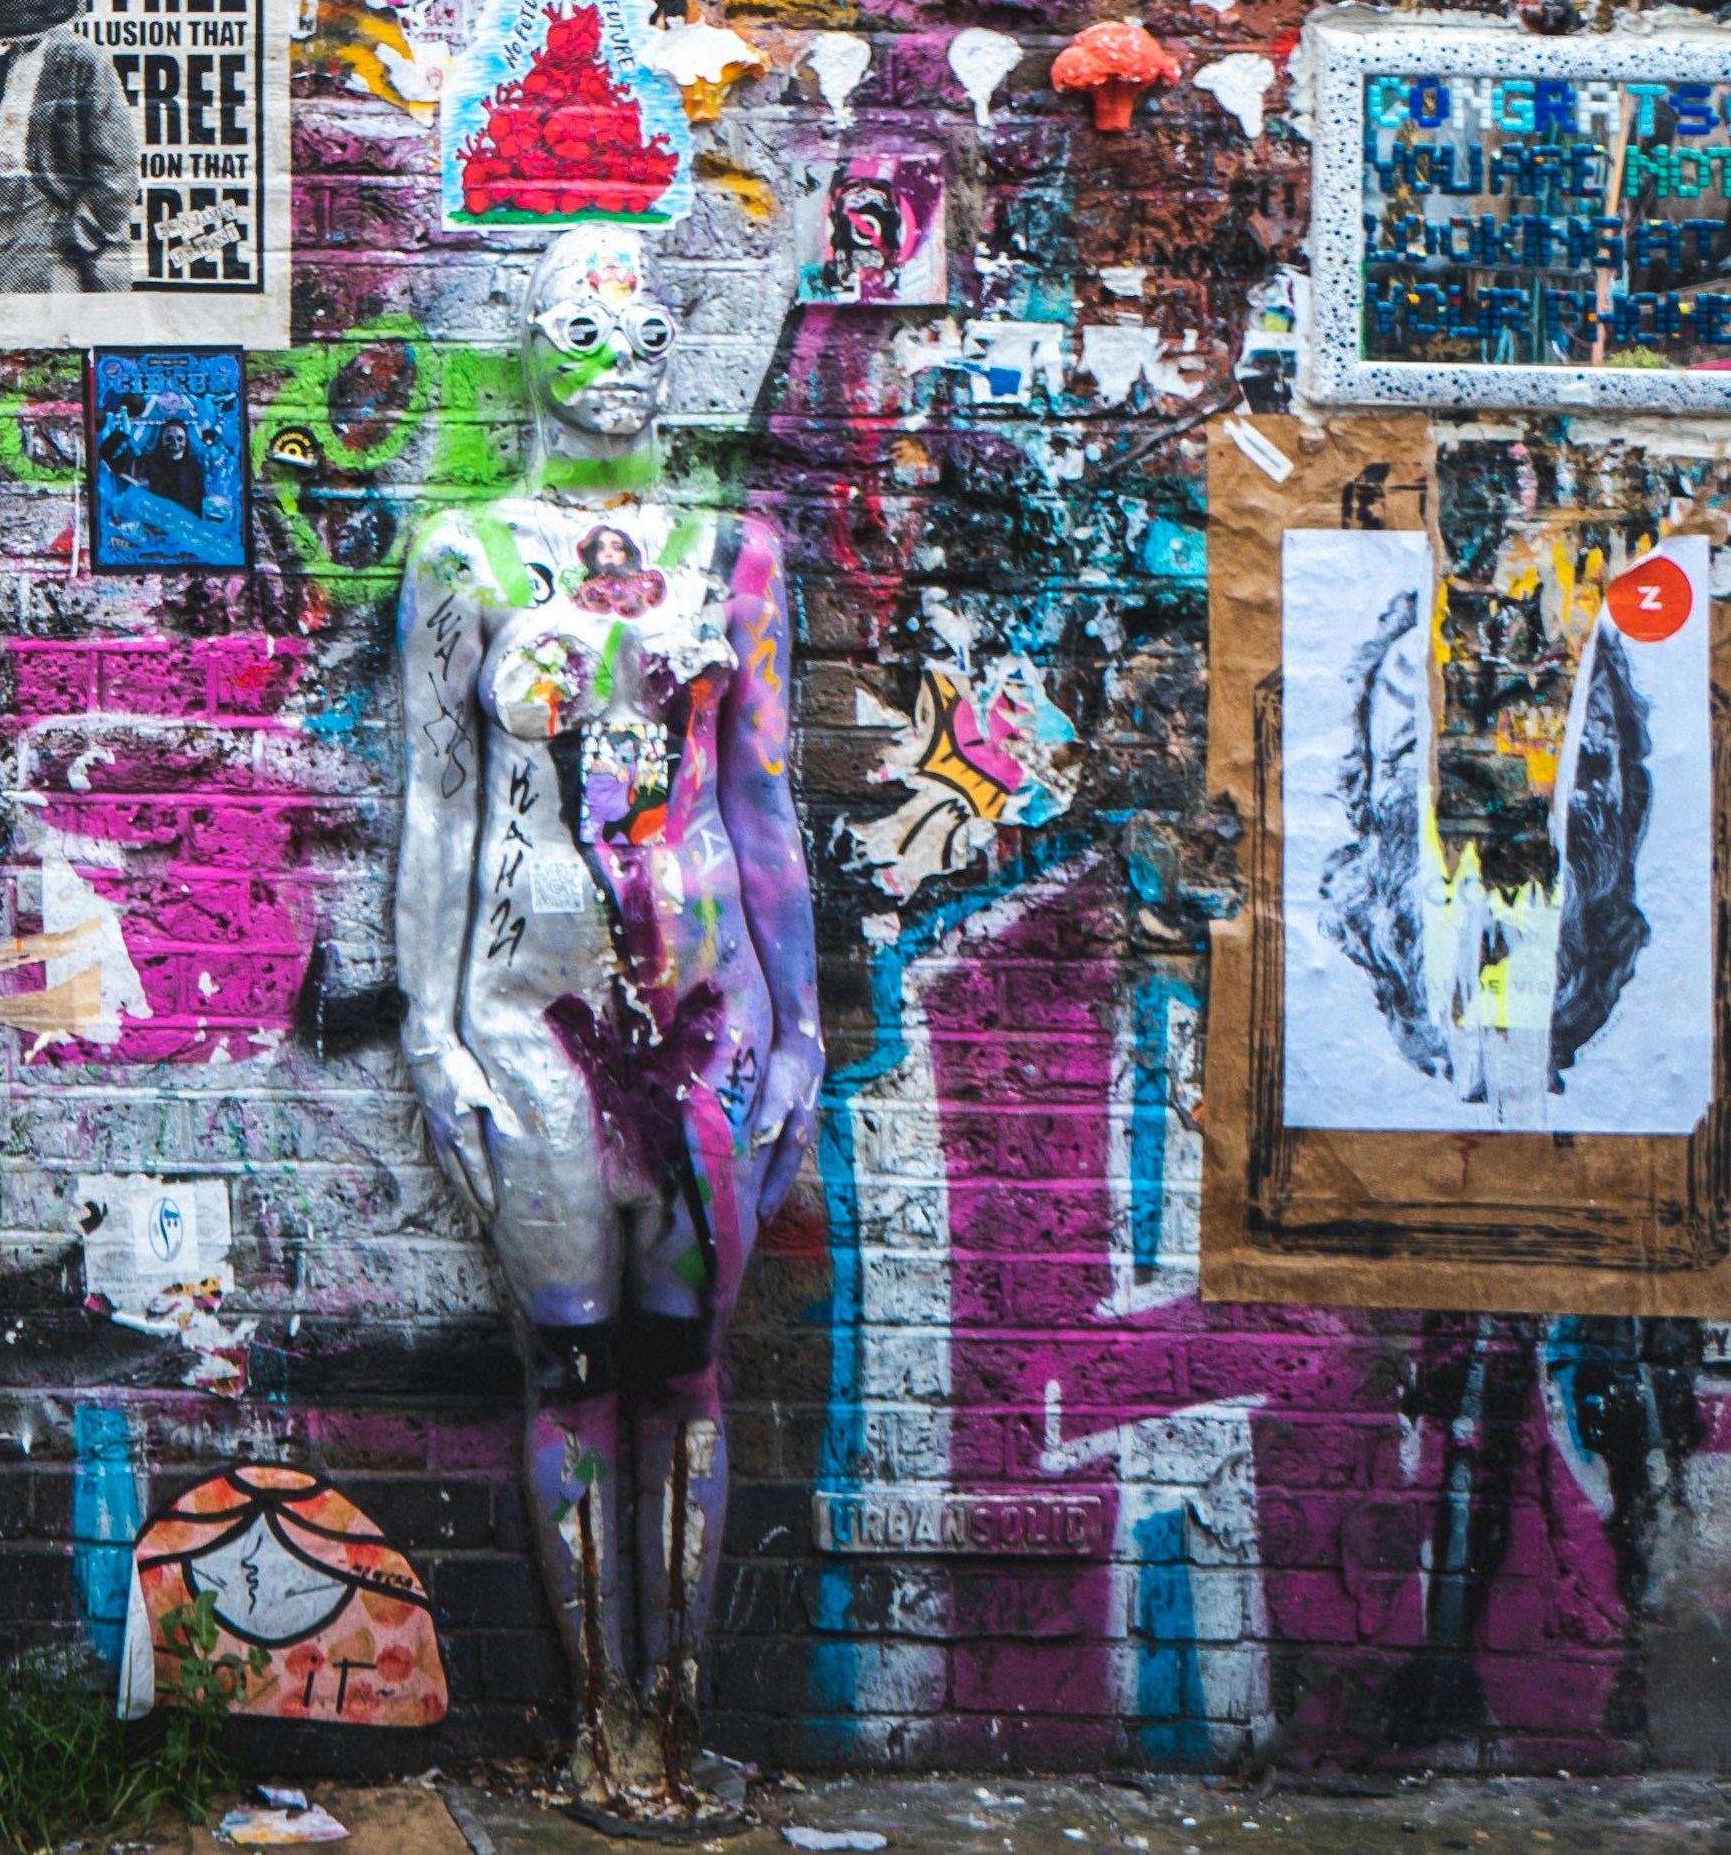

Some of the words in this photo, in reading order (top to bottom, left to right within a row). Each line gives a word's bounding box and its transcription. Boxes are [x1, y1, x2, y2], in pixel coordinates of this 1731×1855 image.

[189, 20, 248, 46] THAT
[1368, 76, 1720, 136] CONGRATS
[192, 153, 249, 178] THAT
